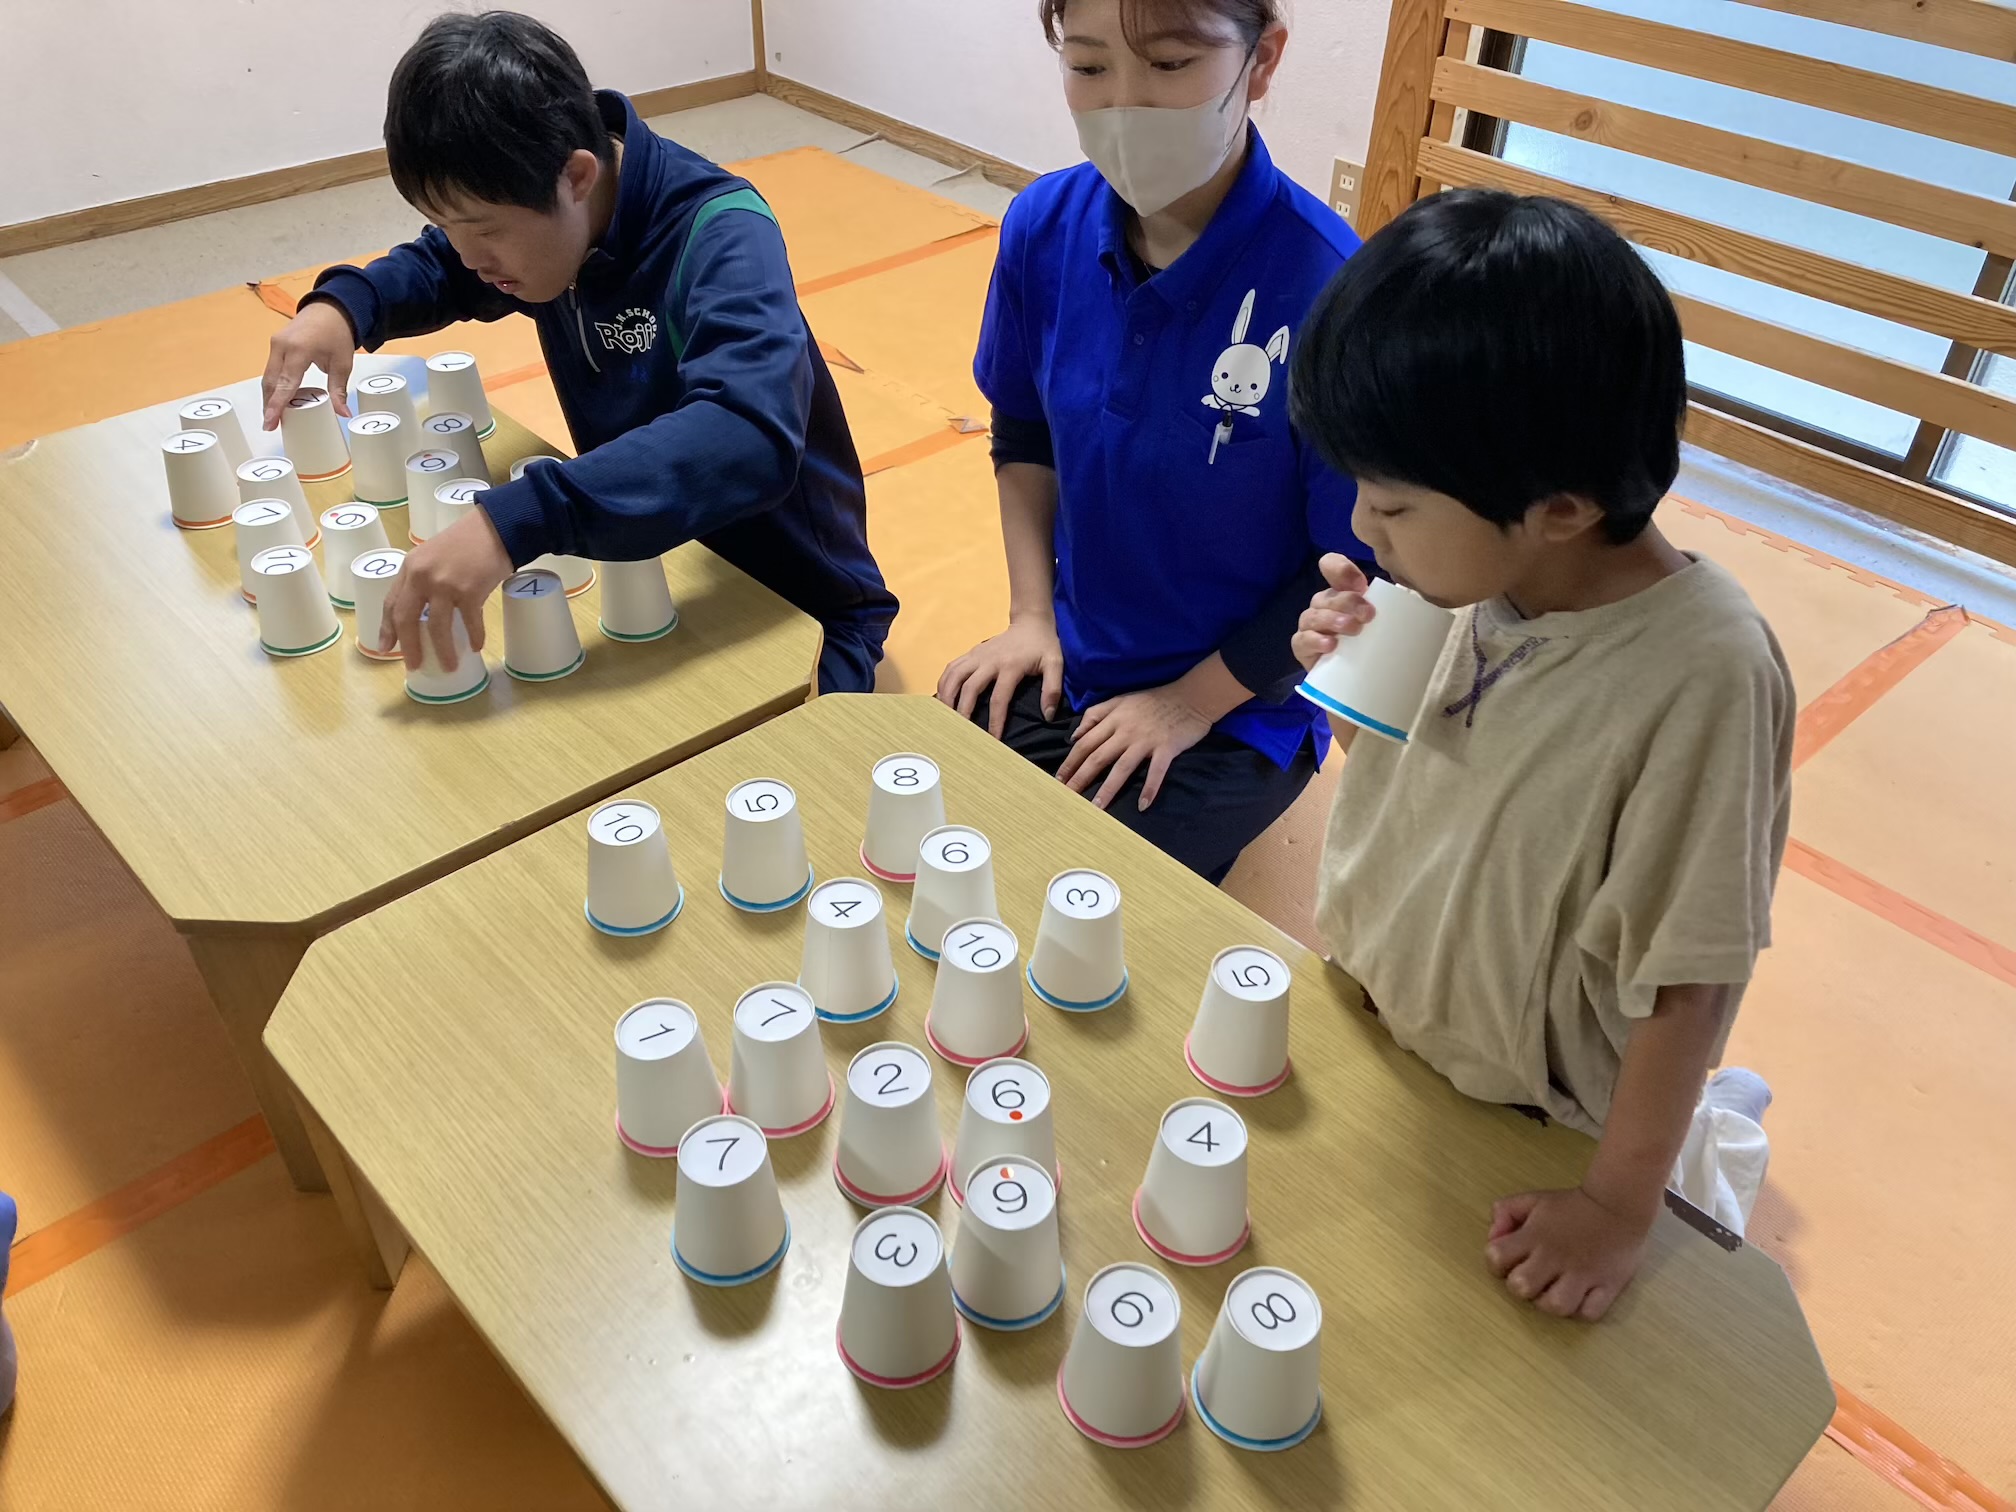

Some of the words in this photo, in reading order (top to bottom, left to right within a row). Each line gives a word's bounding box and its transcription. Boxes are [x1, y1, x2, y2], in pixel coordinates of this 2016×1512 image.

[193, 403, 222, 417] 3
[362, 420, 391, 433] 3
[433, 418, 463, 433] 8
[174, 439, 205, 450] 4
[252, 465, 283, 480] 5
[363, 558, 397, 576] 8
[515, 578, 545, 595] 4
[892, 767, 919, 787] 8
[745, 793, 779, 813] 5
[604, 812, 644, 843] 10
[1066, 888, 1100, 909] 3
[830, 900, 862, 918] 4
[958, 932, 1001, 968] 10
[1231, 965, 1271, 988] 5
[761, 999, 797, 1027] 7
[639, 1023, 675, 1042] 1
[873, 1063, 909, 1095] 2
[1186, 1120, 1220, 1152] 4
[705, 1137, 740, 1170] 7
[875, 1233, 918, 1268] 3
[1250, 1292, 1297, 1330] 8
